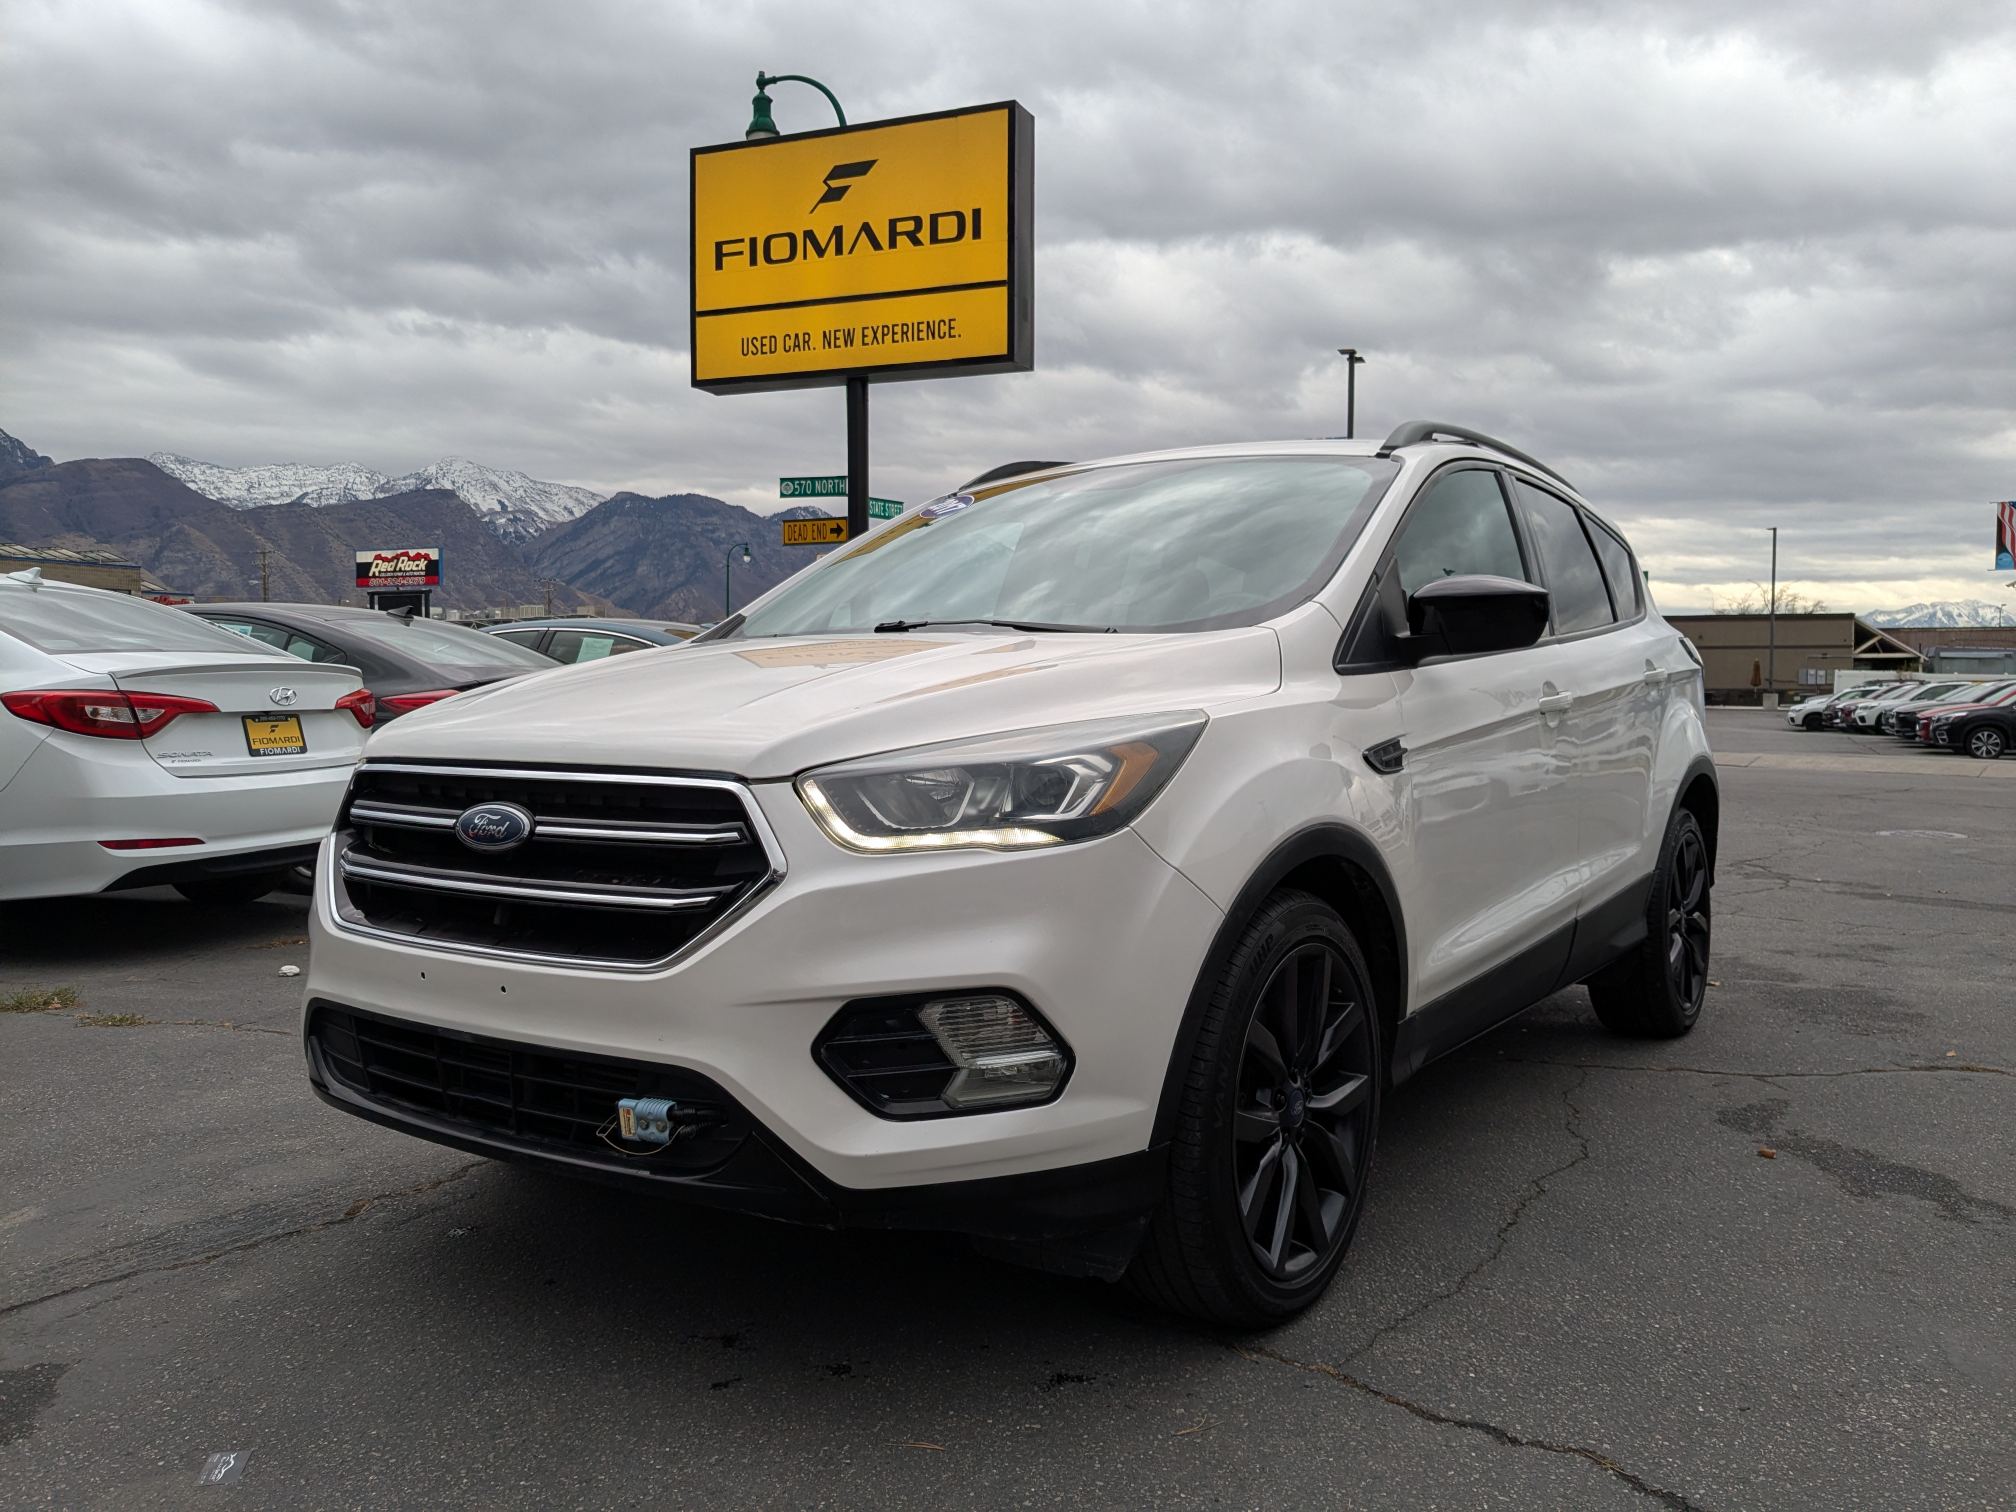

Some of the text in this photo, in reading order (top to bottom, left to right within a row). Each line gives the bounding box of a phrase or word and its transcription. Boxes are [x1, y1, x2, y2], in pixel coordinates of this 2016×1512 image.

[714, 207, 982, 271] FIOMARDI
[741, 317, 962, 357] USED CAR. NEW EXPERIENCE.
[794, 479, 845, 494] 570 NORTH
[870, 500, 884, 516] STATE
[787, 522, 828, 541] DEAD END
[369, 557, 428, 576] Red Rock
[252, 736, 301, 745] FIOMARDI
[156, 751, 214, 759] SONATA
[260, 746, 301, 755] FIOMARDI
[469, 813, 510, 838] Ford
